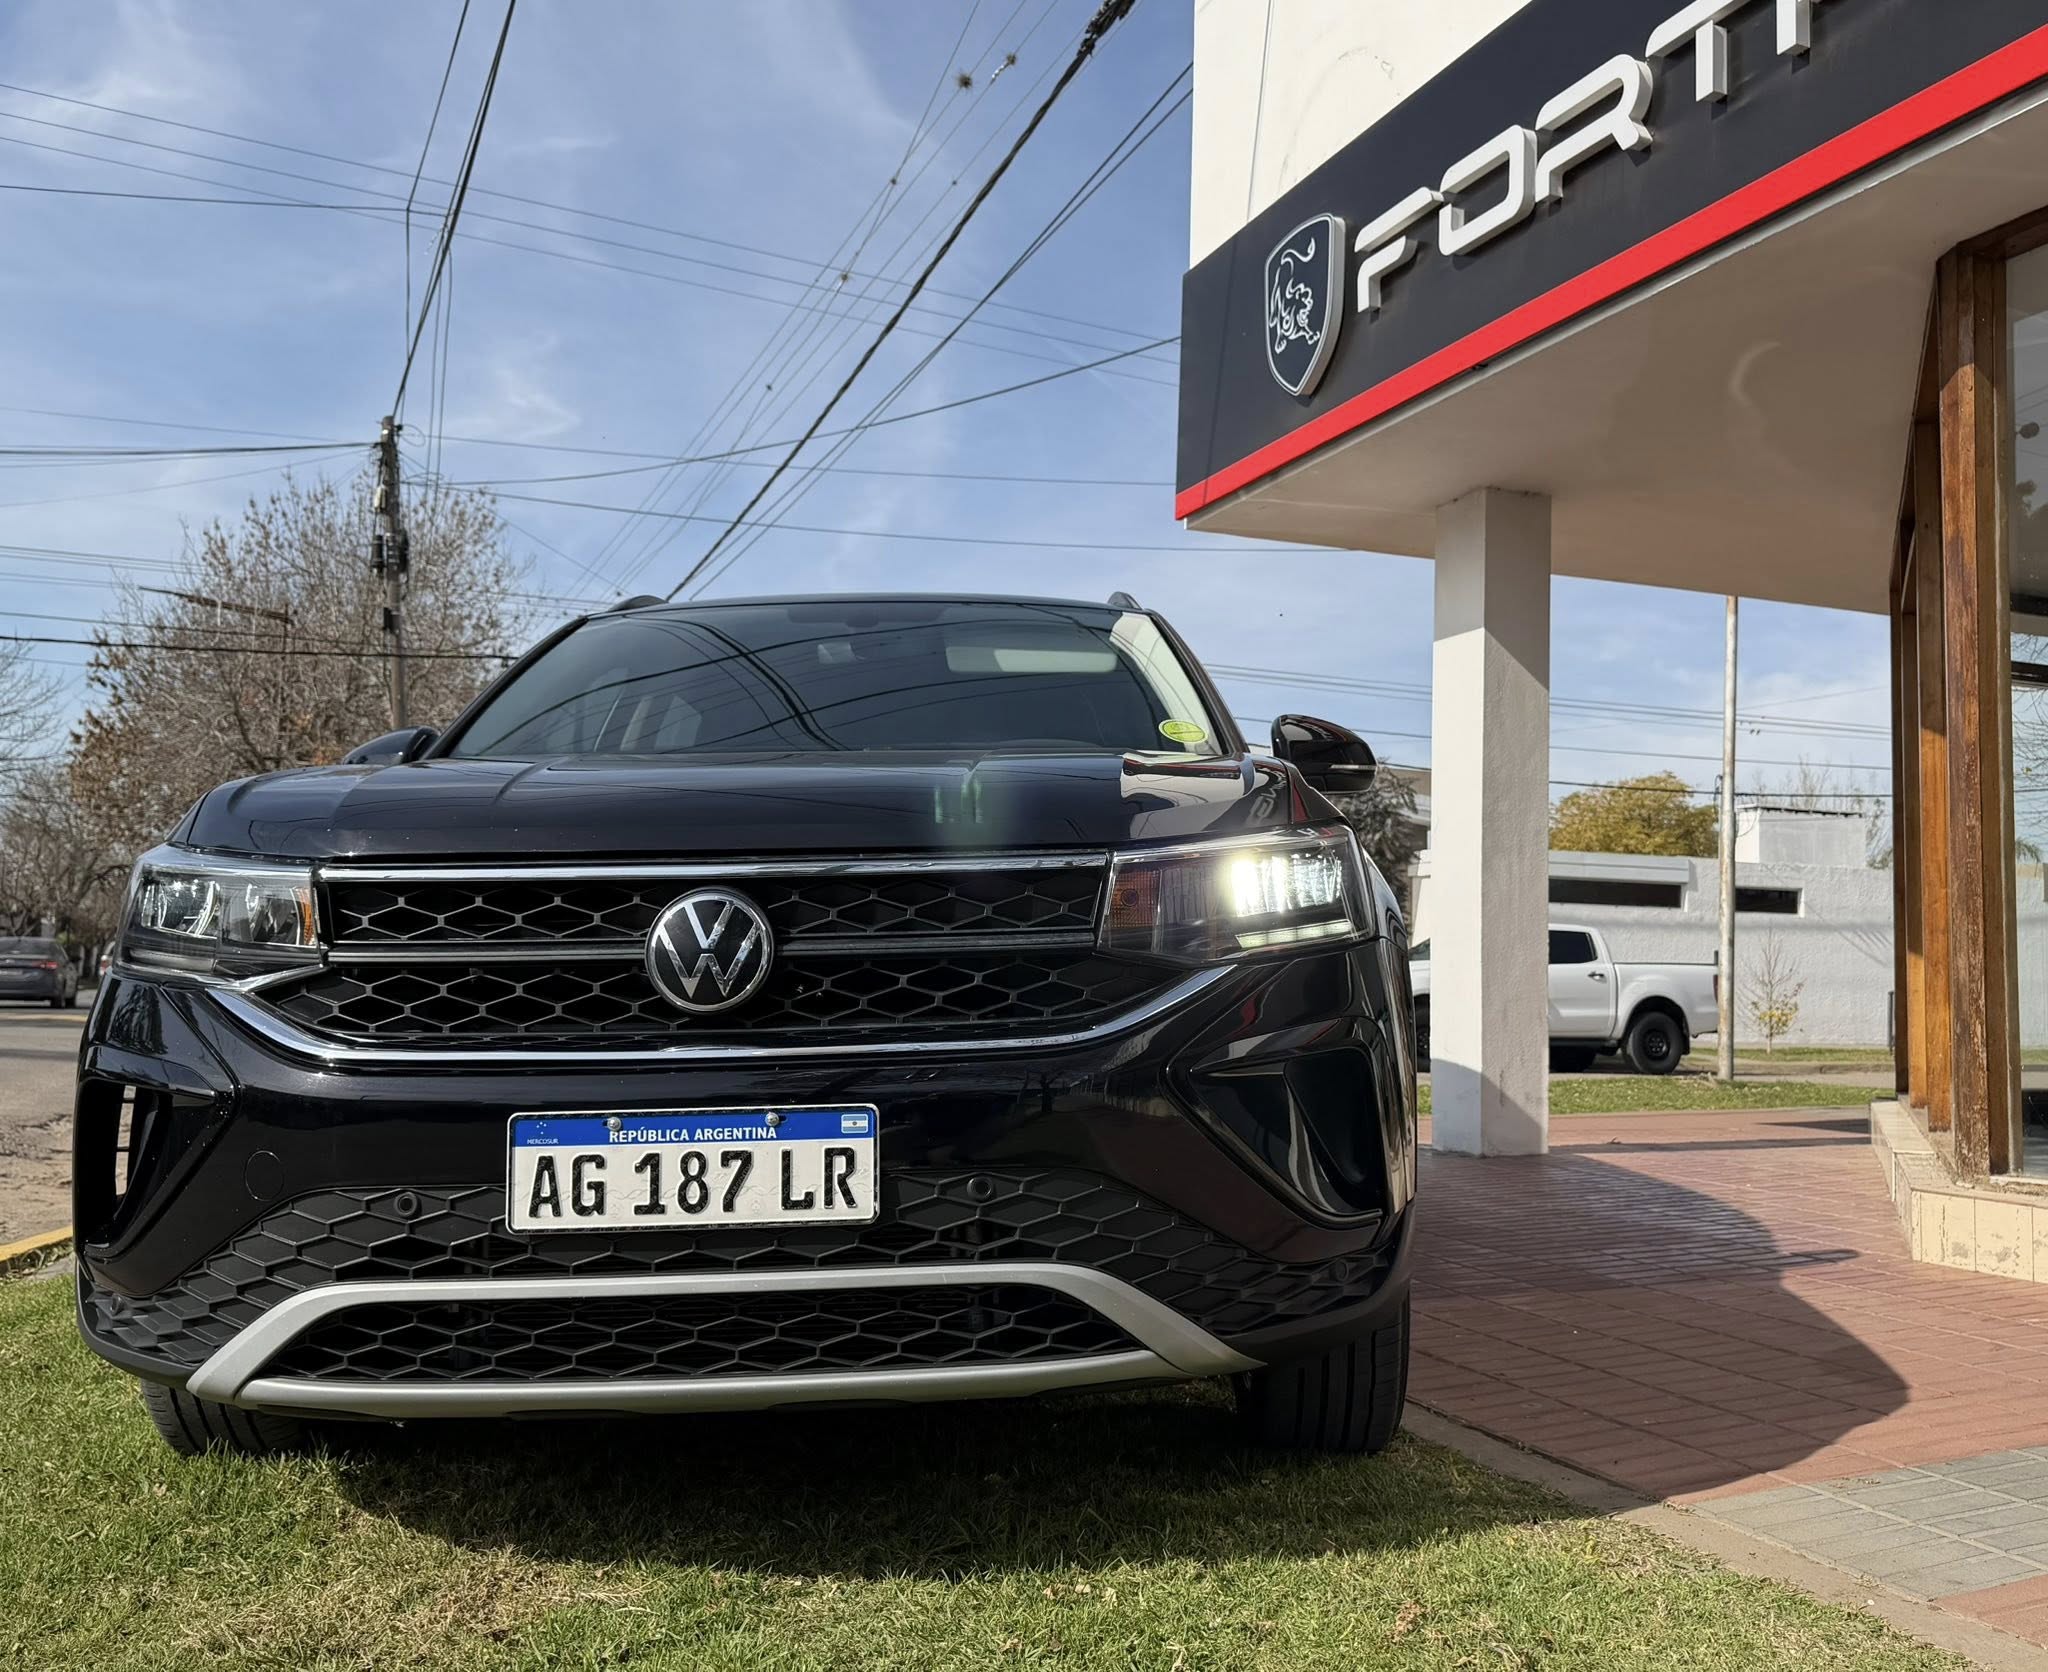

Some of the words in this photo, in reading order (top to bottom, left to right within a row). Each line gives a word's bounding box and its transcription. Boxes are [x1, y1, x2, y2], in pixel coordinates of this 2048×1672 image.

[650, 892, 767, 1003] VW
[526, 1137, 559, 1145] MERCOSUR
[608, 1126, 690, 1144] REPÚBLICA
[693, 1125, 777, 1142] ARGENTINA
[527, 1153, 607, 1219] AG
[632, 1150, 755, 1216] 187
[780, 1147, 858, 1211] LR
